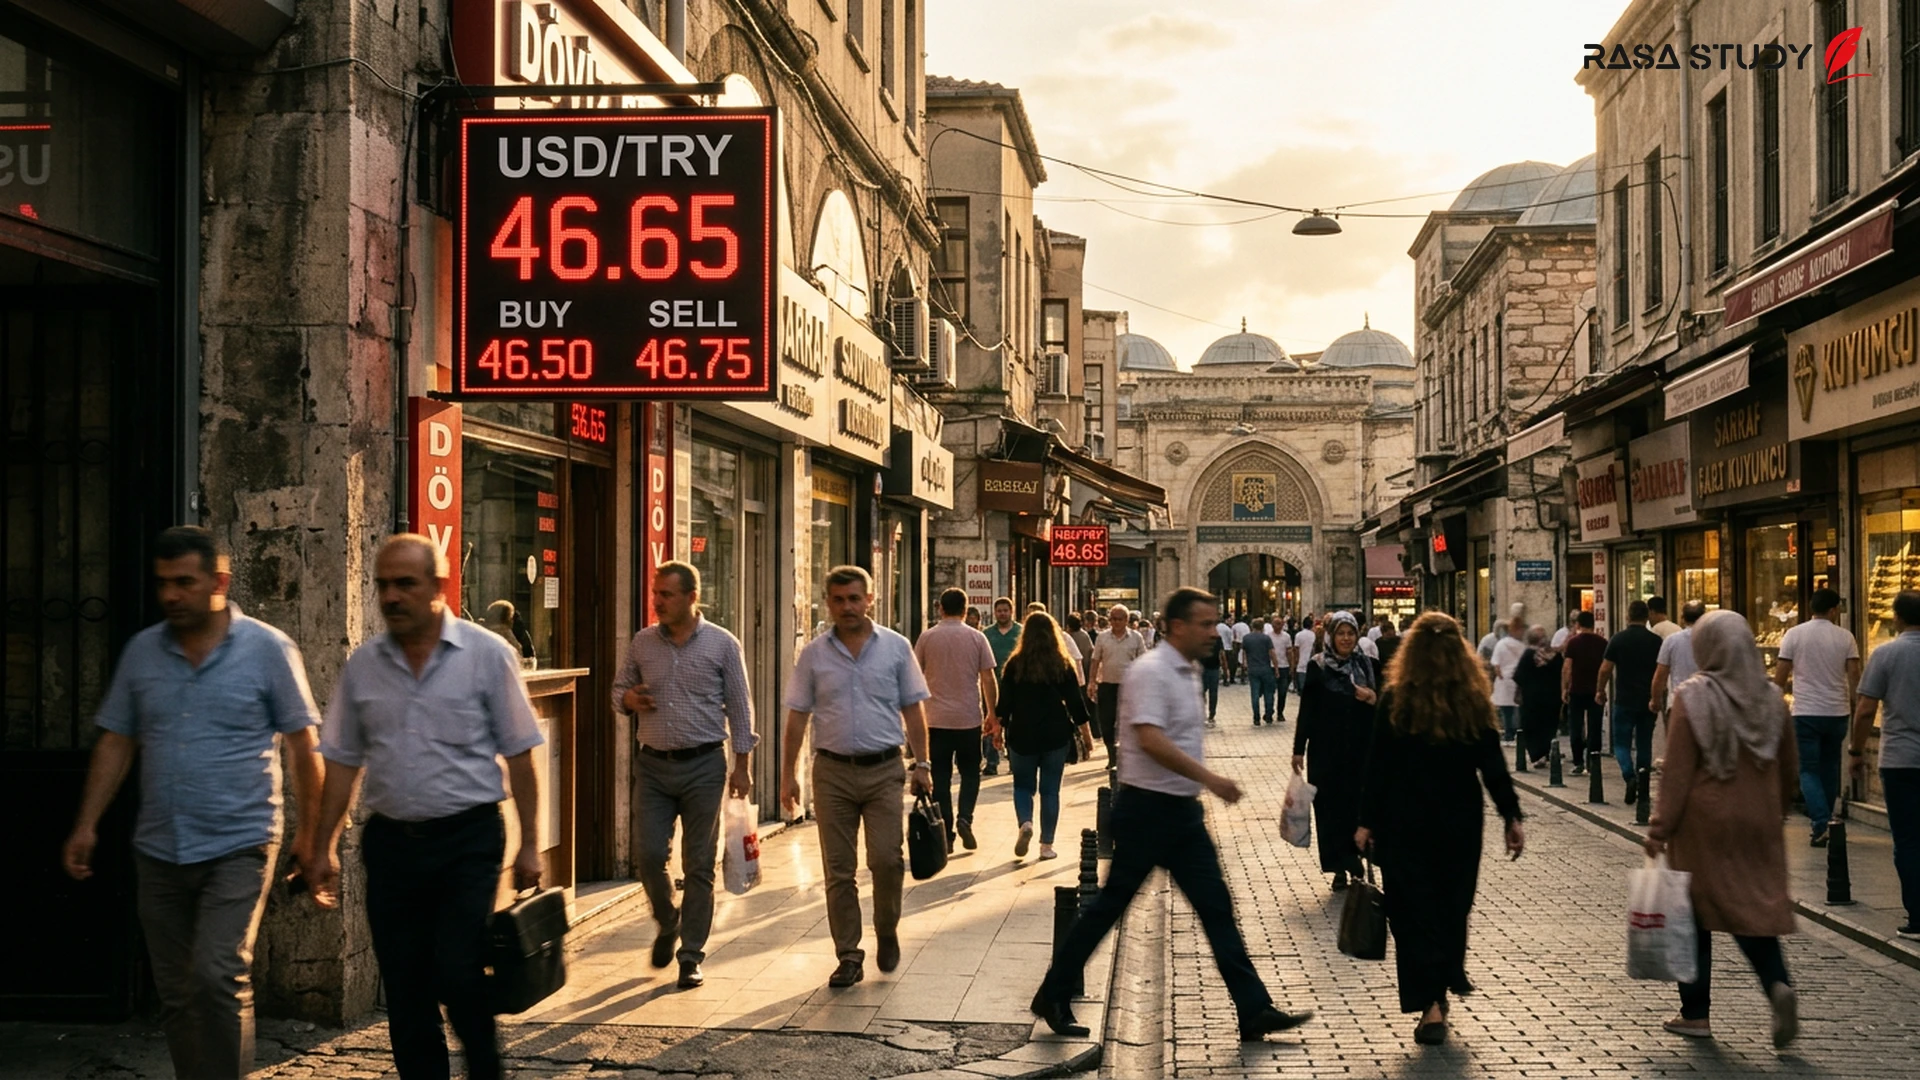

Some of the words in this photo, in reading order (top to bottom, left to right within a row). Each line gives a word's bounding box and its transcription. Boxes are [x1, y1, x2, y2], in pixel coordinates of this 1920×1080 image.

[499, 134, 732, 178] USD/TRY
[490, 195, 739, 280] 46.65
[500, 301, 572, 328] BUY
[649, 300, 737, 328] SELL
[478, 339, 593, 380] 46.50
[636, 338, 751, 380] 46.75
[1715, 401, 1760, 448] SARRAF
[1728, 443, 1787, 489] KUYUMCU
[1054, 543, 1104, 560] 46.65
